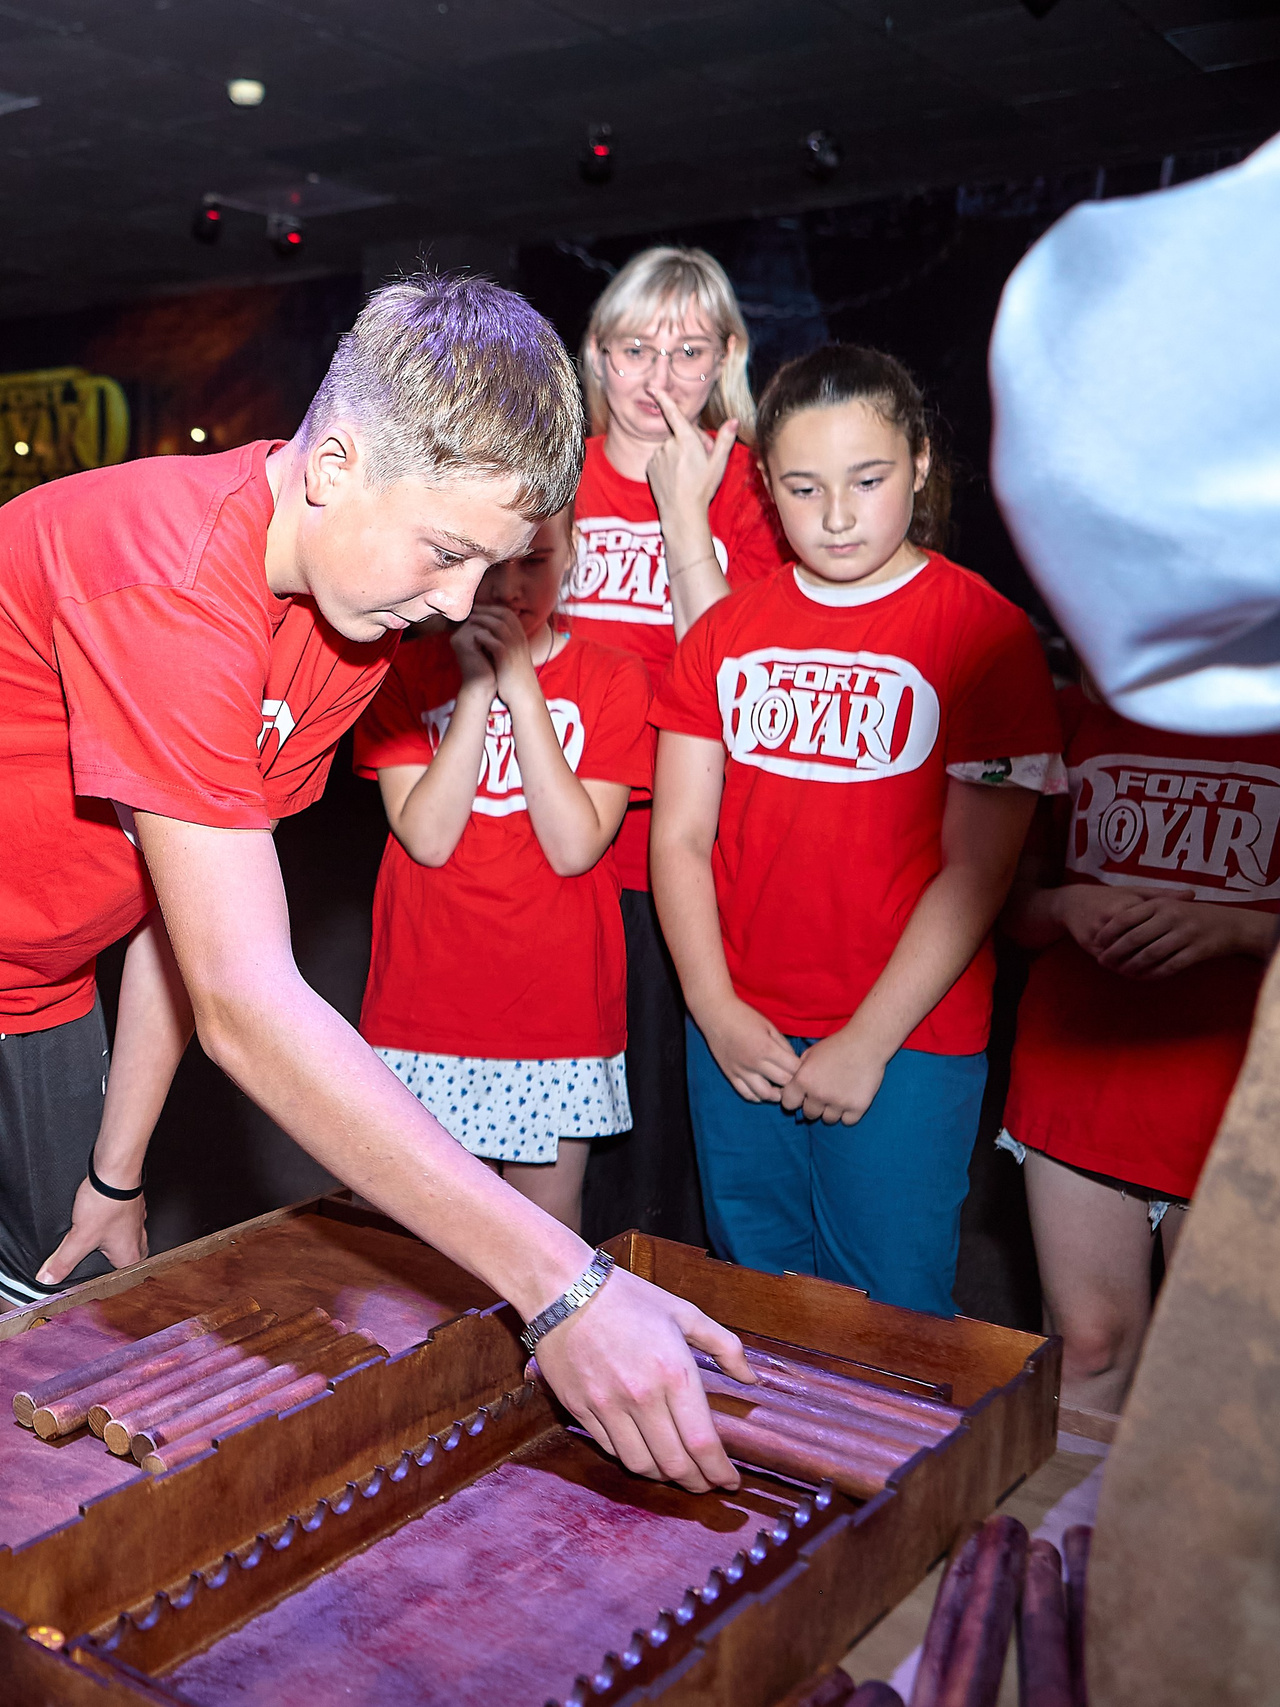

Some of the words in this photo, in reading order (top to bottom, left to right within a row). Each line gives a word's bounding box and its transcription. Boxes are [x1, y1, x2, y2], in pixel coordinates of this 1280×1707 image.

[769, 662, 877, 693] FORT
[716, 655, 940, 772] BOYARD
[1116, 770, 1250, 804] FORT
